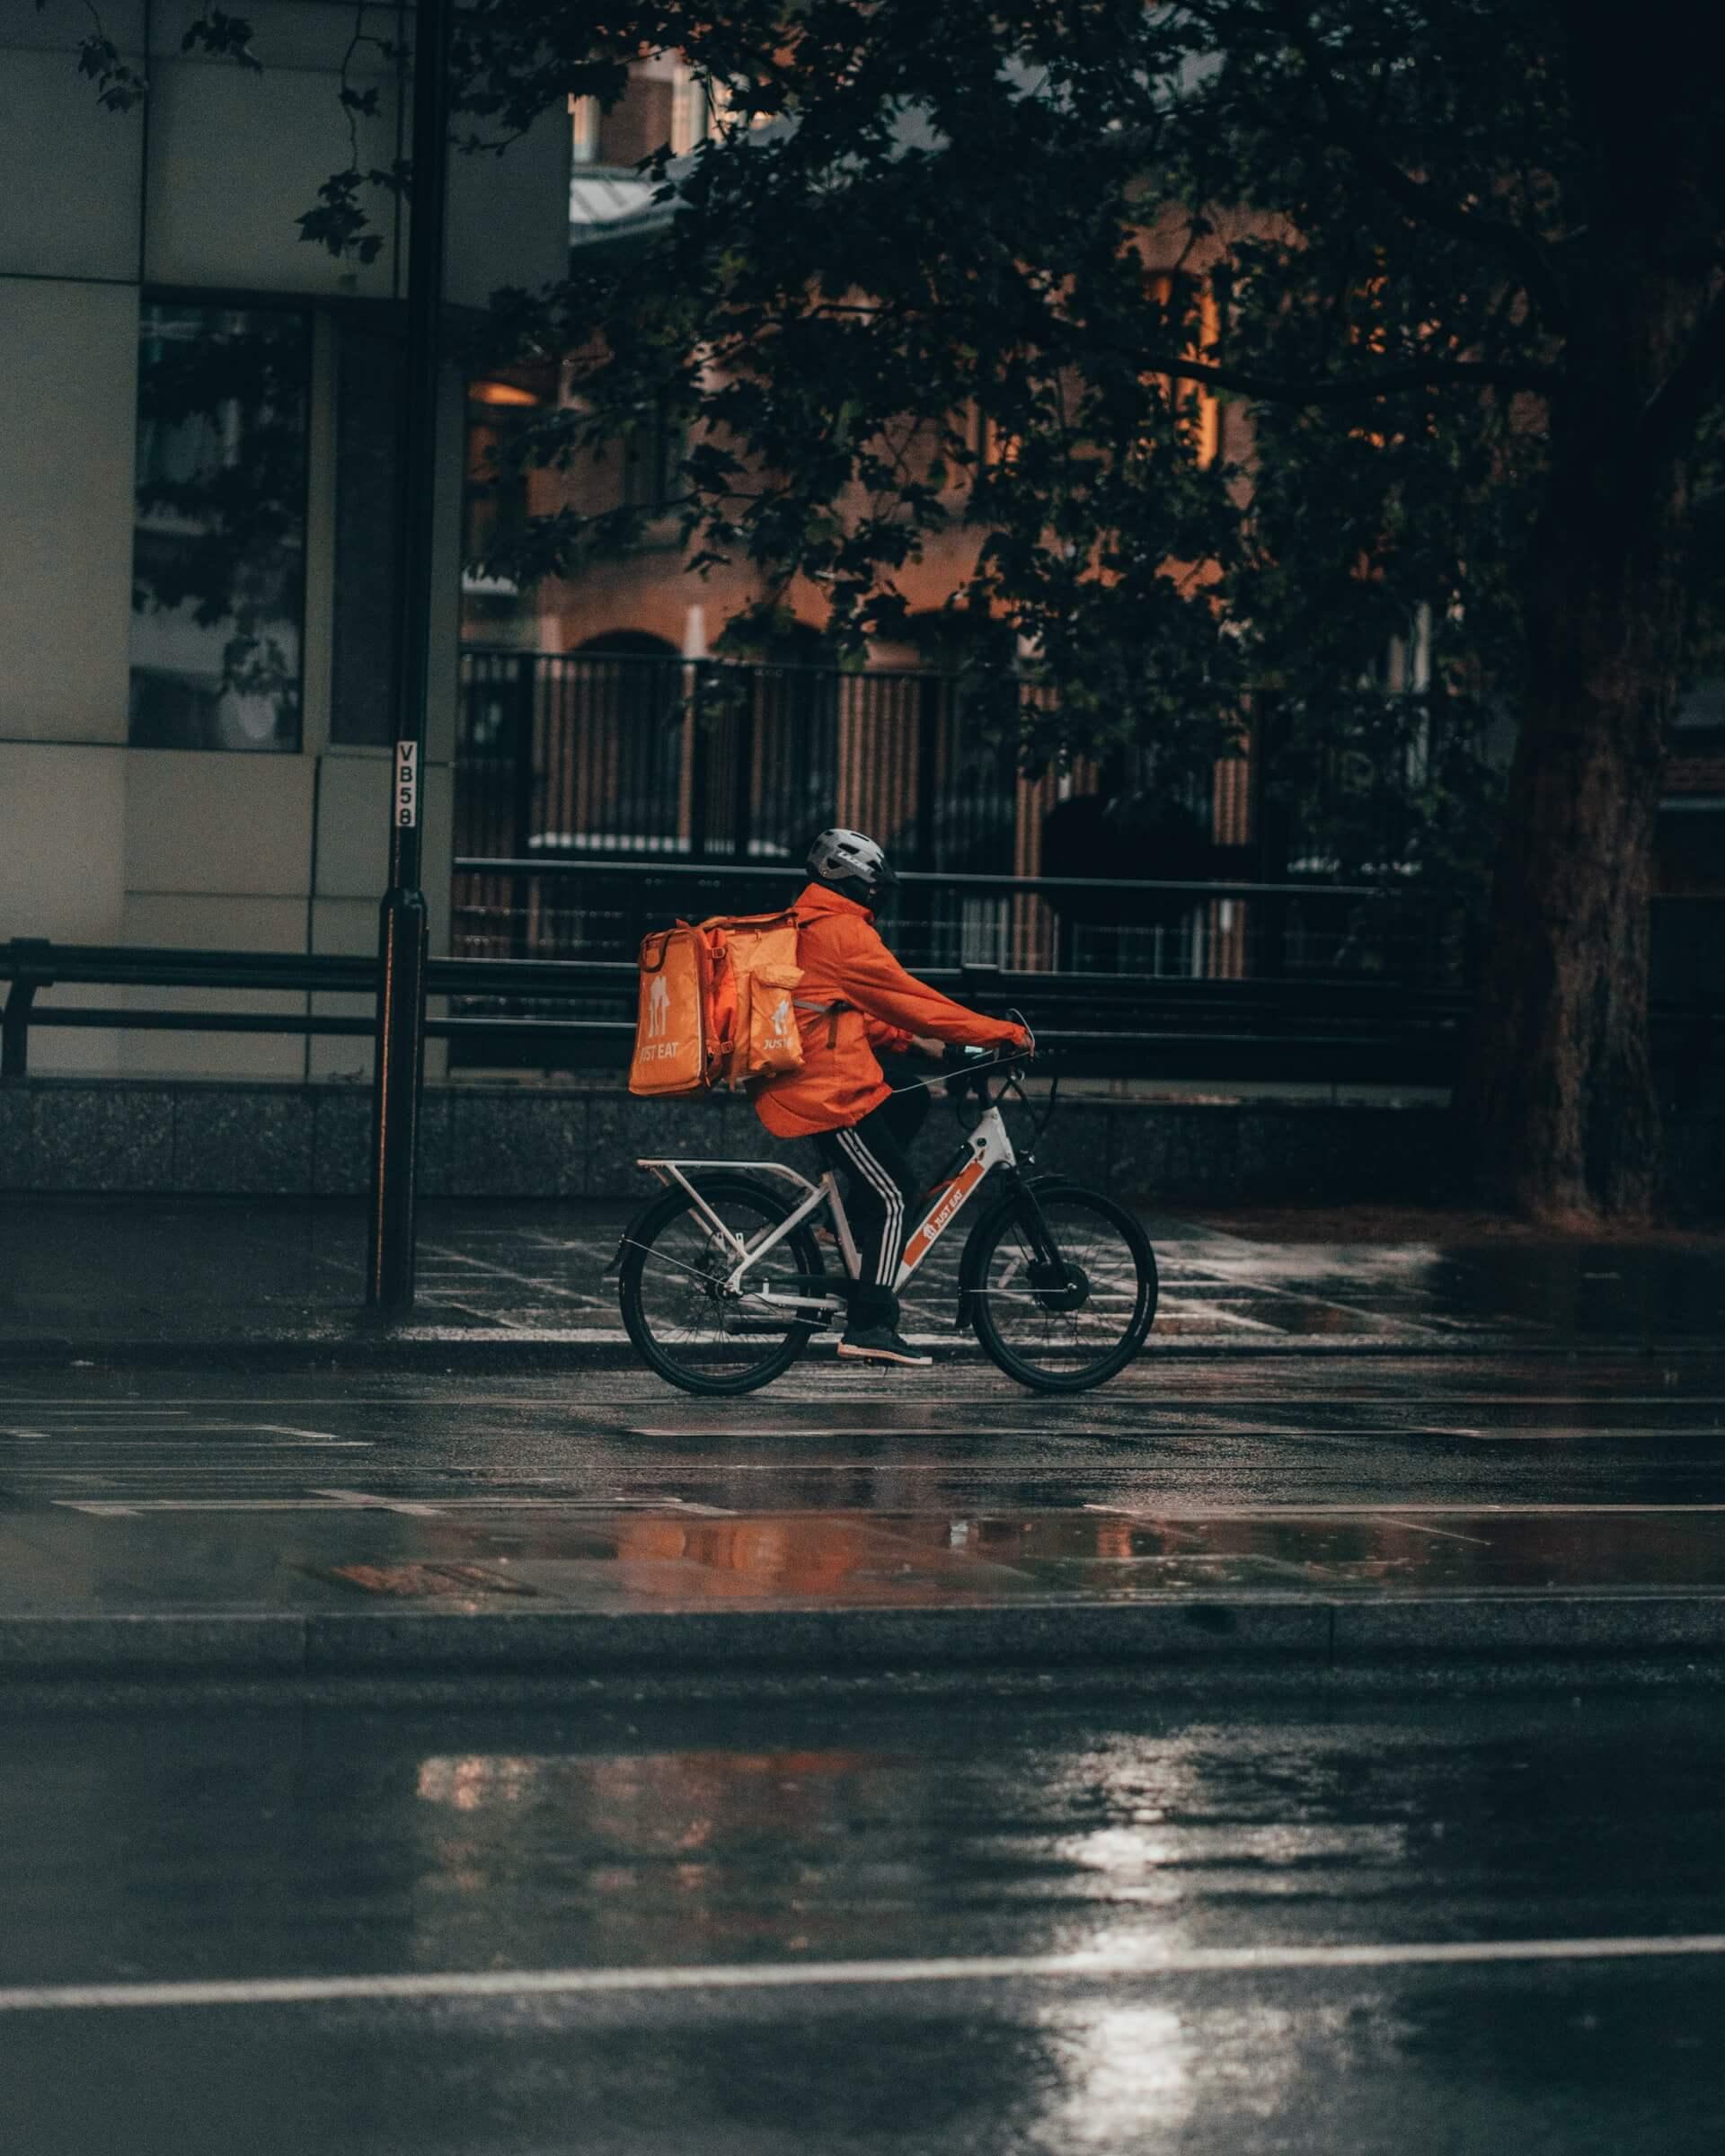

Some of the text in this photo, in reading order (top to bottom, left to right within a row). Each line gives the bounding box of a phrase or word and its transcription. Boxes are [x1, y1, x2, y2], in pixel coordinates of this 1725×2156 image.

[400, 745, 412, 825] VB58
[658, 1042, 679, 1059] EAT
[933, 1188, 963, 1228] JUST EAT
